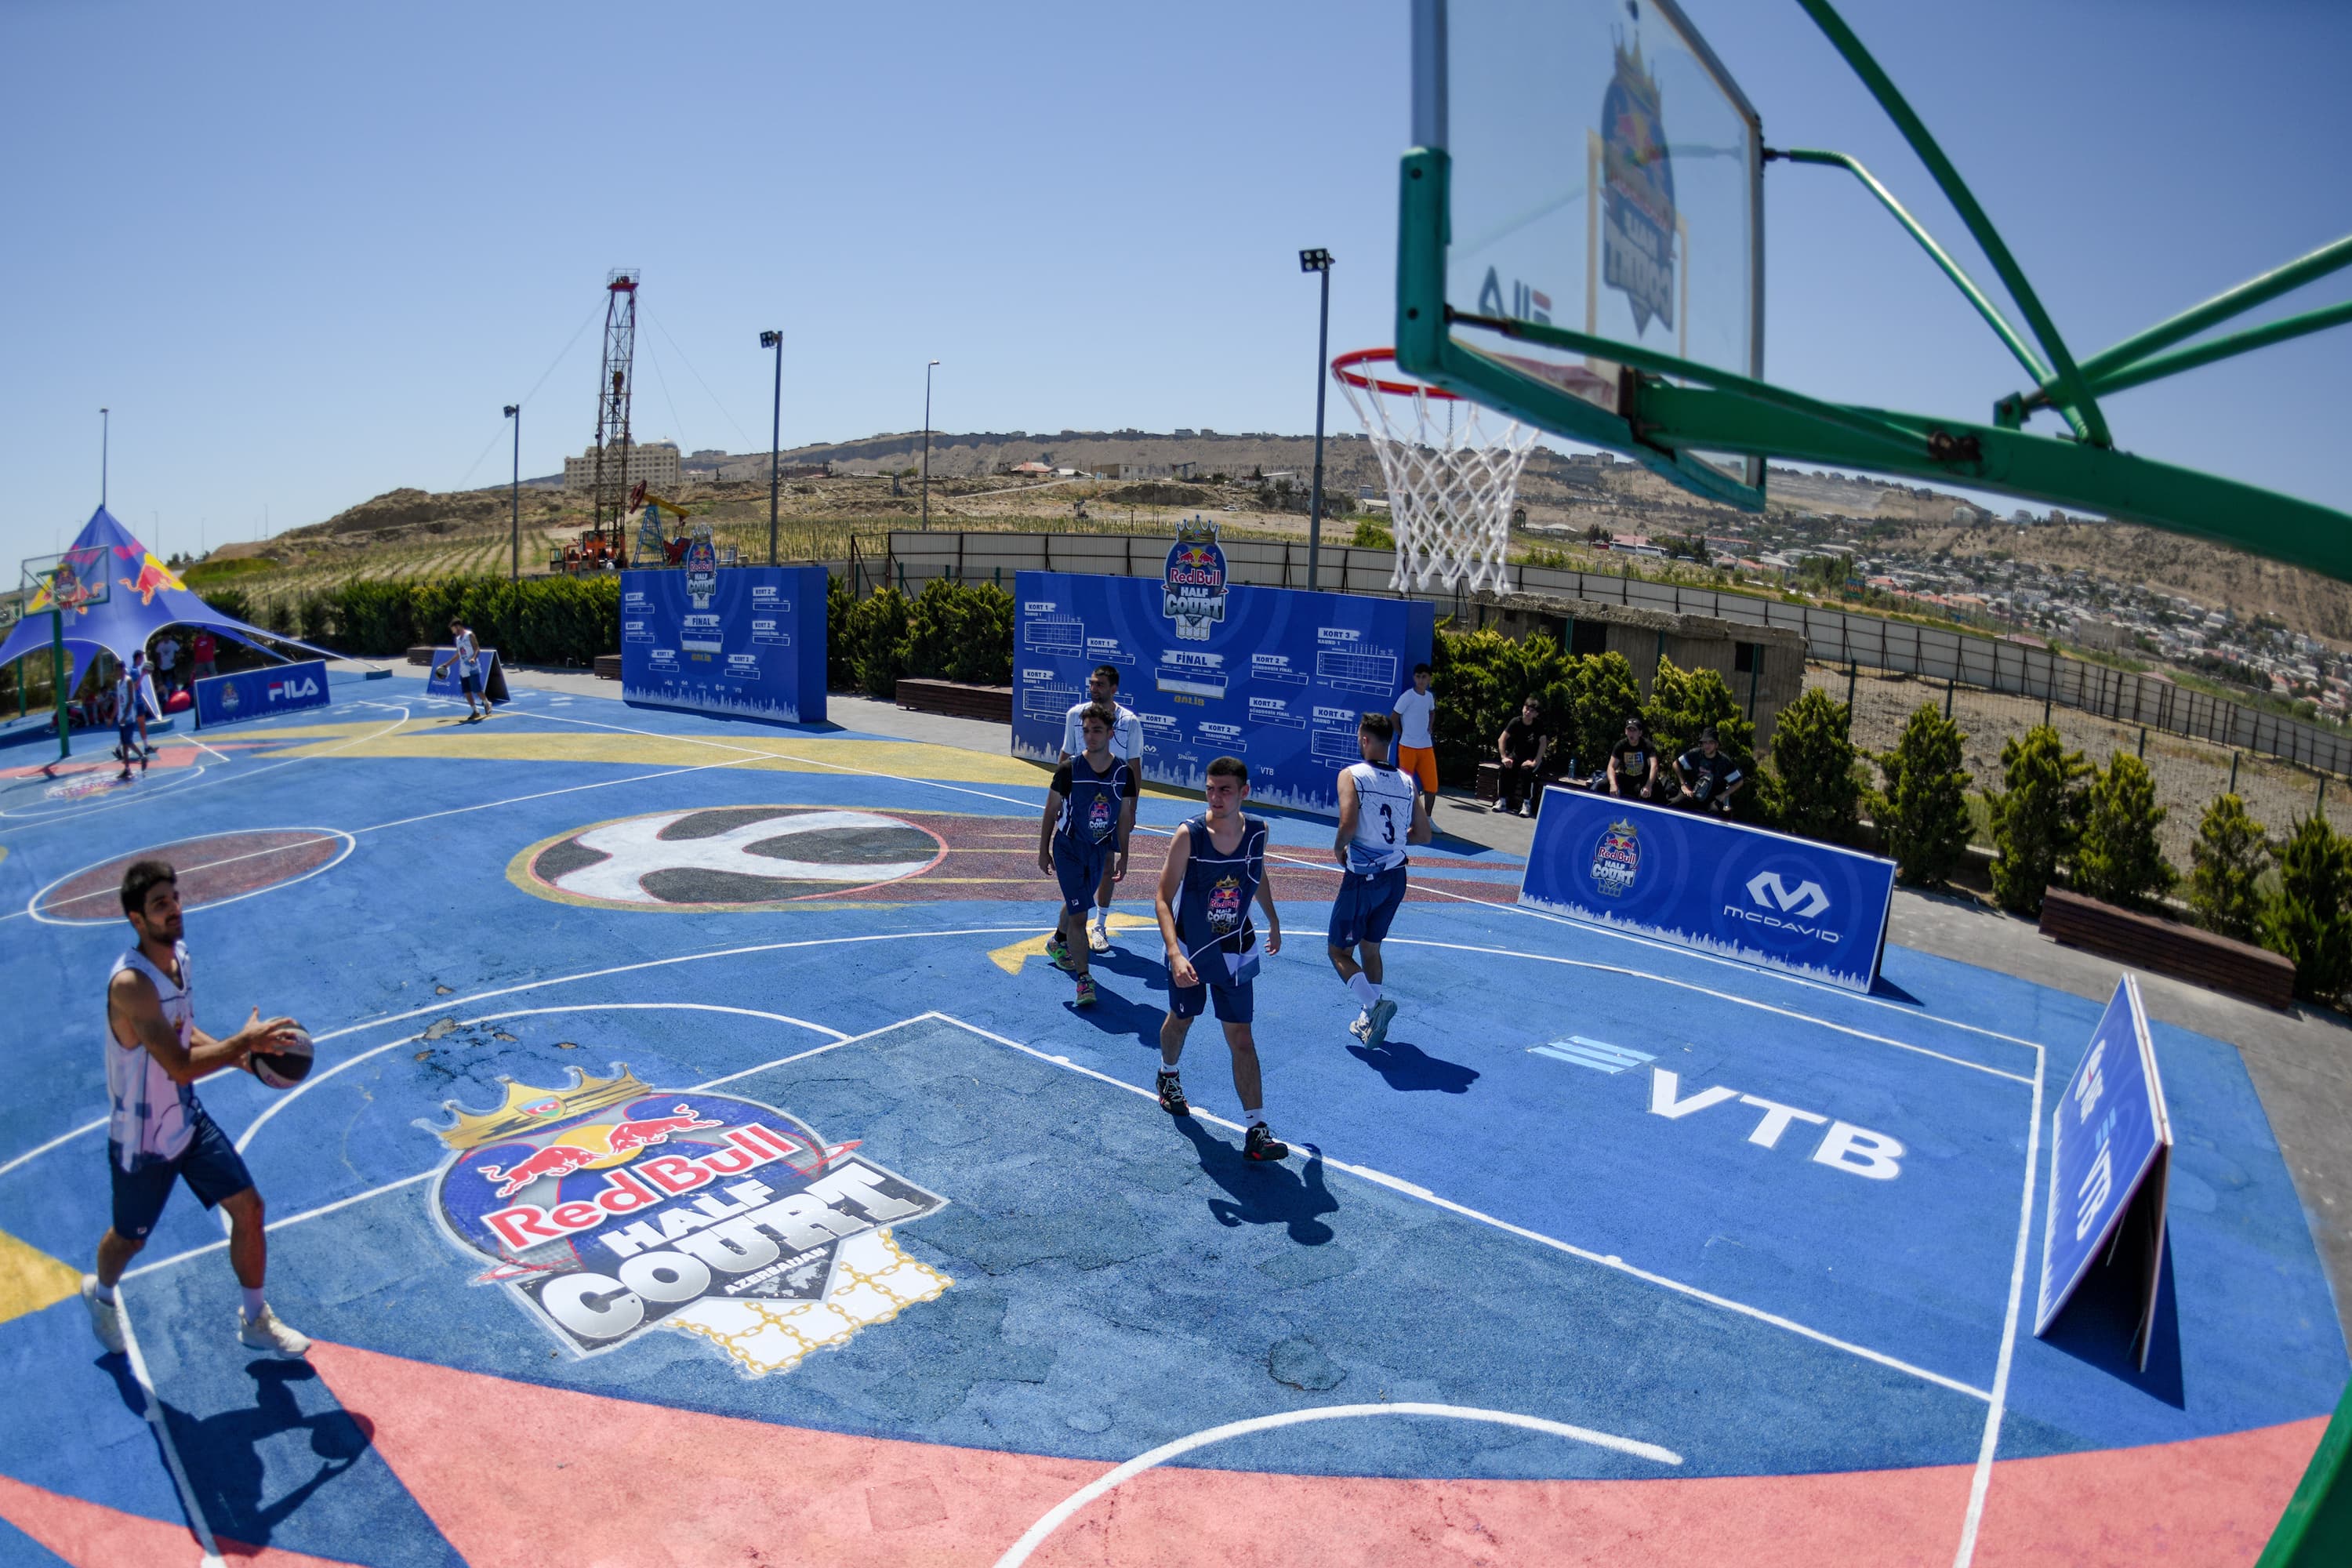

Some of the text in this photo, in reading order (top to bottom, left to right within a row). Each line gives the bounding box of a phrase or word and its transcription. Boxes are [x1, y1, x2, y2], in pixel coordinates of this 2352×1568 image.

[1170, 568, 1221, 586] Red Bull
[1181, 586, 1208, 597] HALF
[1166, 594, 1222, 619] COURT
[1176, 652, 1208, 666] FİNAL
[269, 677, 319, 702] FILA
[1318, 709, 1338, 717] KORT
[1261, 766, 1274, 775] VTB
[1380, 804, 1395, 844] 3
[1599, 847, 1636, 864] Red Bull
[1605, 860, 1625, 869] HALF
[1592, 863, 1634, 884] COURT
[1207, 910, 1237, 924] COURT
[1650, 1067, 1903, 1180] VTB
[484, 1124, 798, 1250] Red Bull
[2077, 1137, 2111, 1241] VTB
[598, 1179, 775, 1257] HALF
[542, 1161, 921, 1338] COURT
[724, 1247, 828, 1294] AZERBAIJAN
